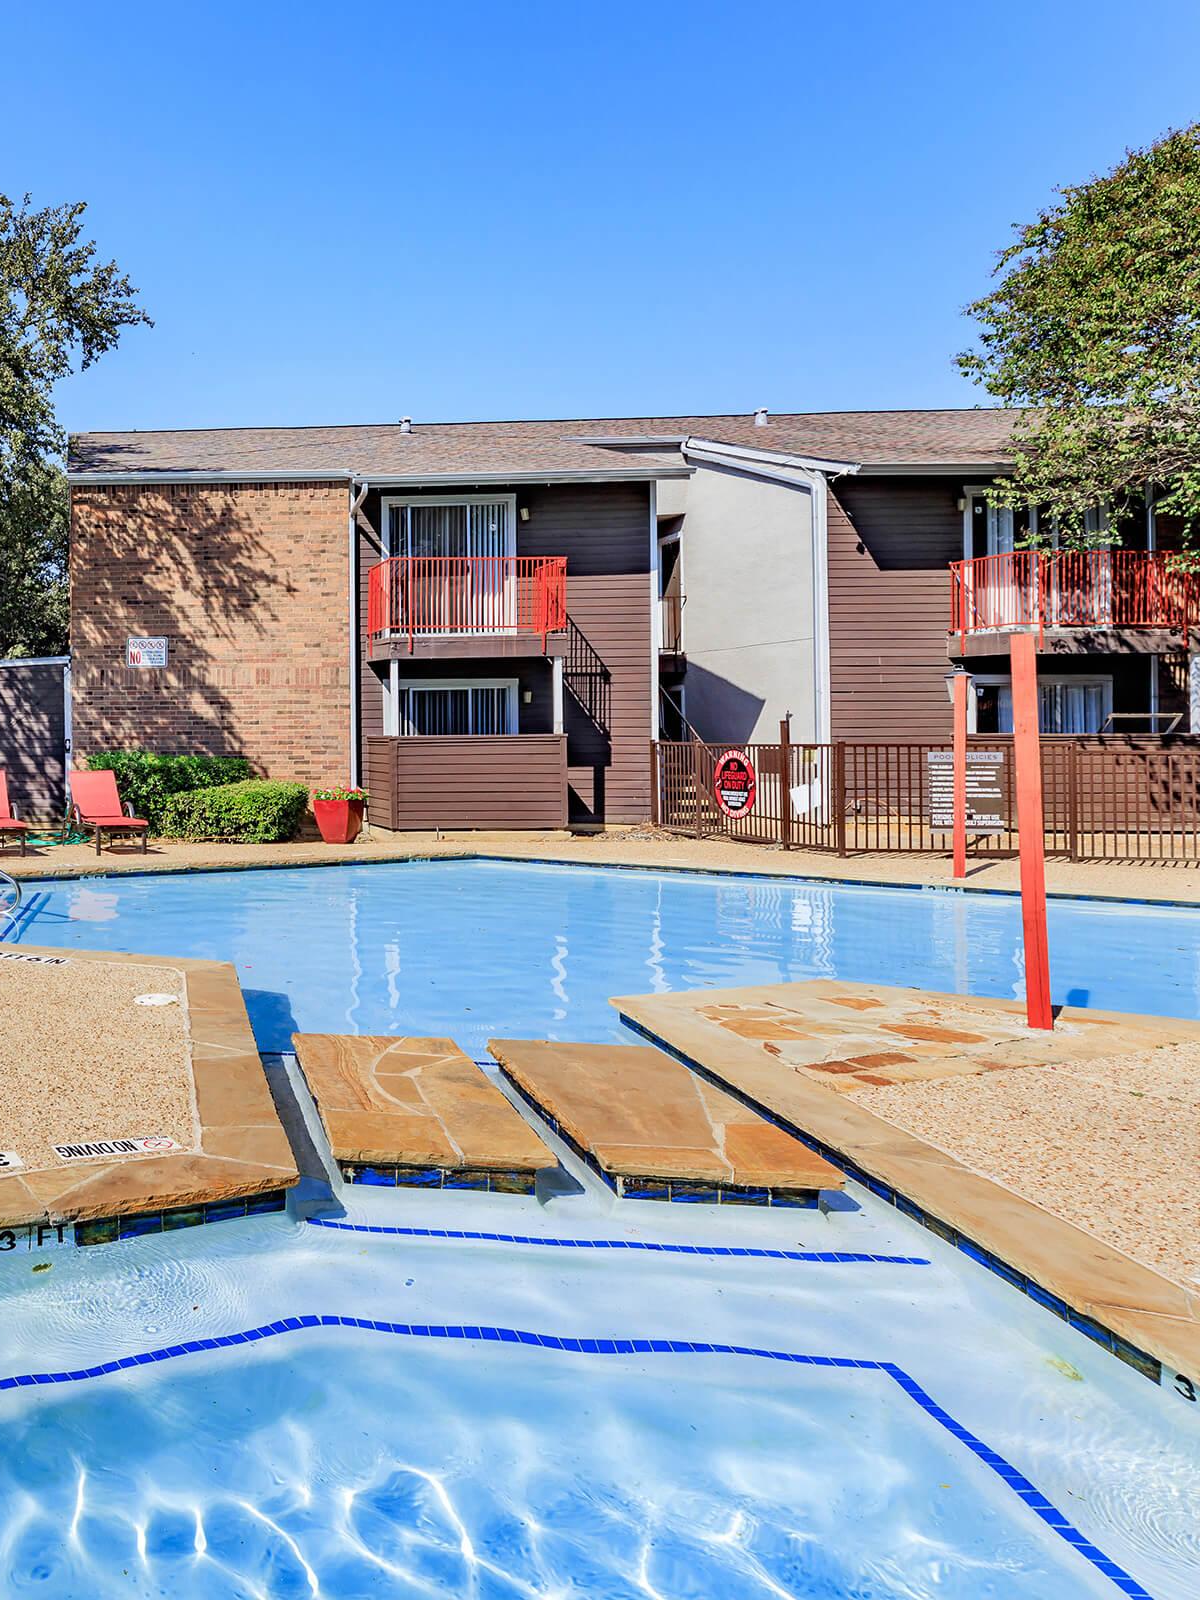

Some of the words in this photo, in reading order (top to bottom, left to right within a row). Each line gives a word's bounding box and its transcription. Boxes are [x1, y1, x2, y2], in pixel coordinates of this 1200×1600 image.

[130, 651, 141, 664] NO
[719, 749, 749, 766] WARNING
[730, 762, 738, 770] NO
[722, 771, 747, 780] LIFEGUARD
[724, 781, 731, 789] ON
[732, 781, 745, 790] DUTY
[721, 802, 730, 814] NO
[730, 806, 749, 819] DIVING
[55, 1142, 116, 1158] DIVING
[112, 1140, 139, 1152] NO
[37, 1222, 69, 1247] FT
[1173, 1373, 1197, 1402] 3
